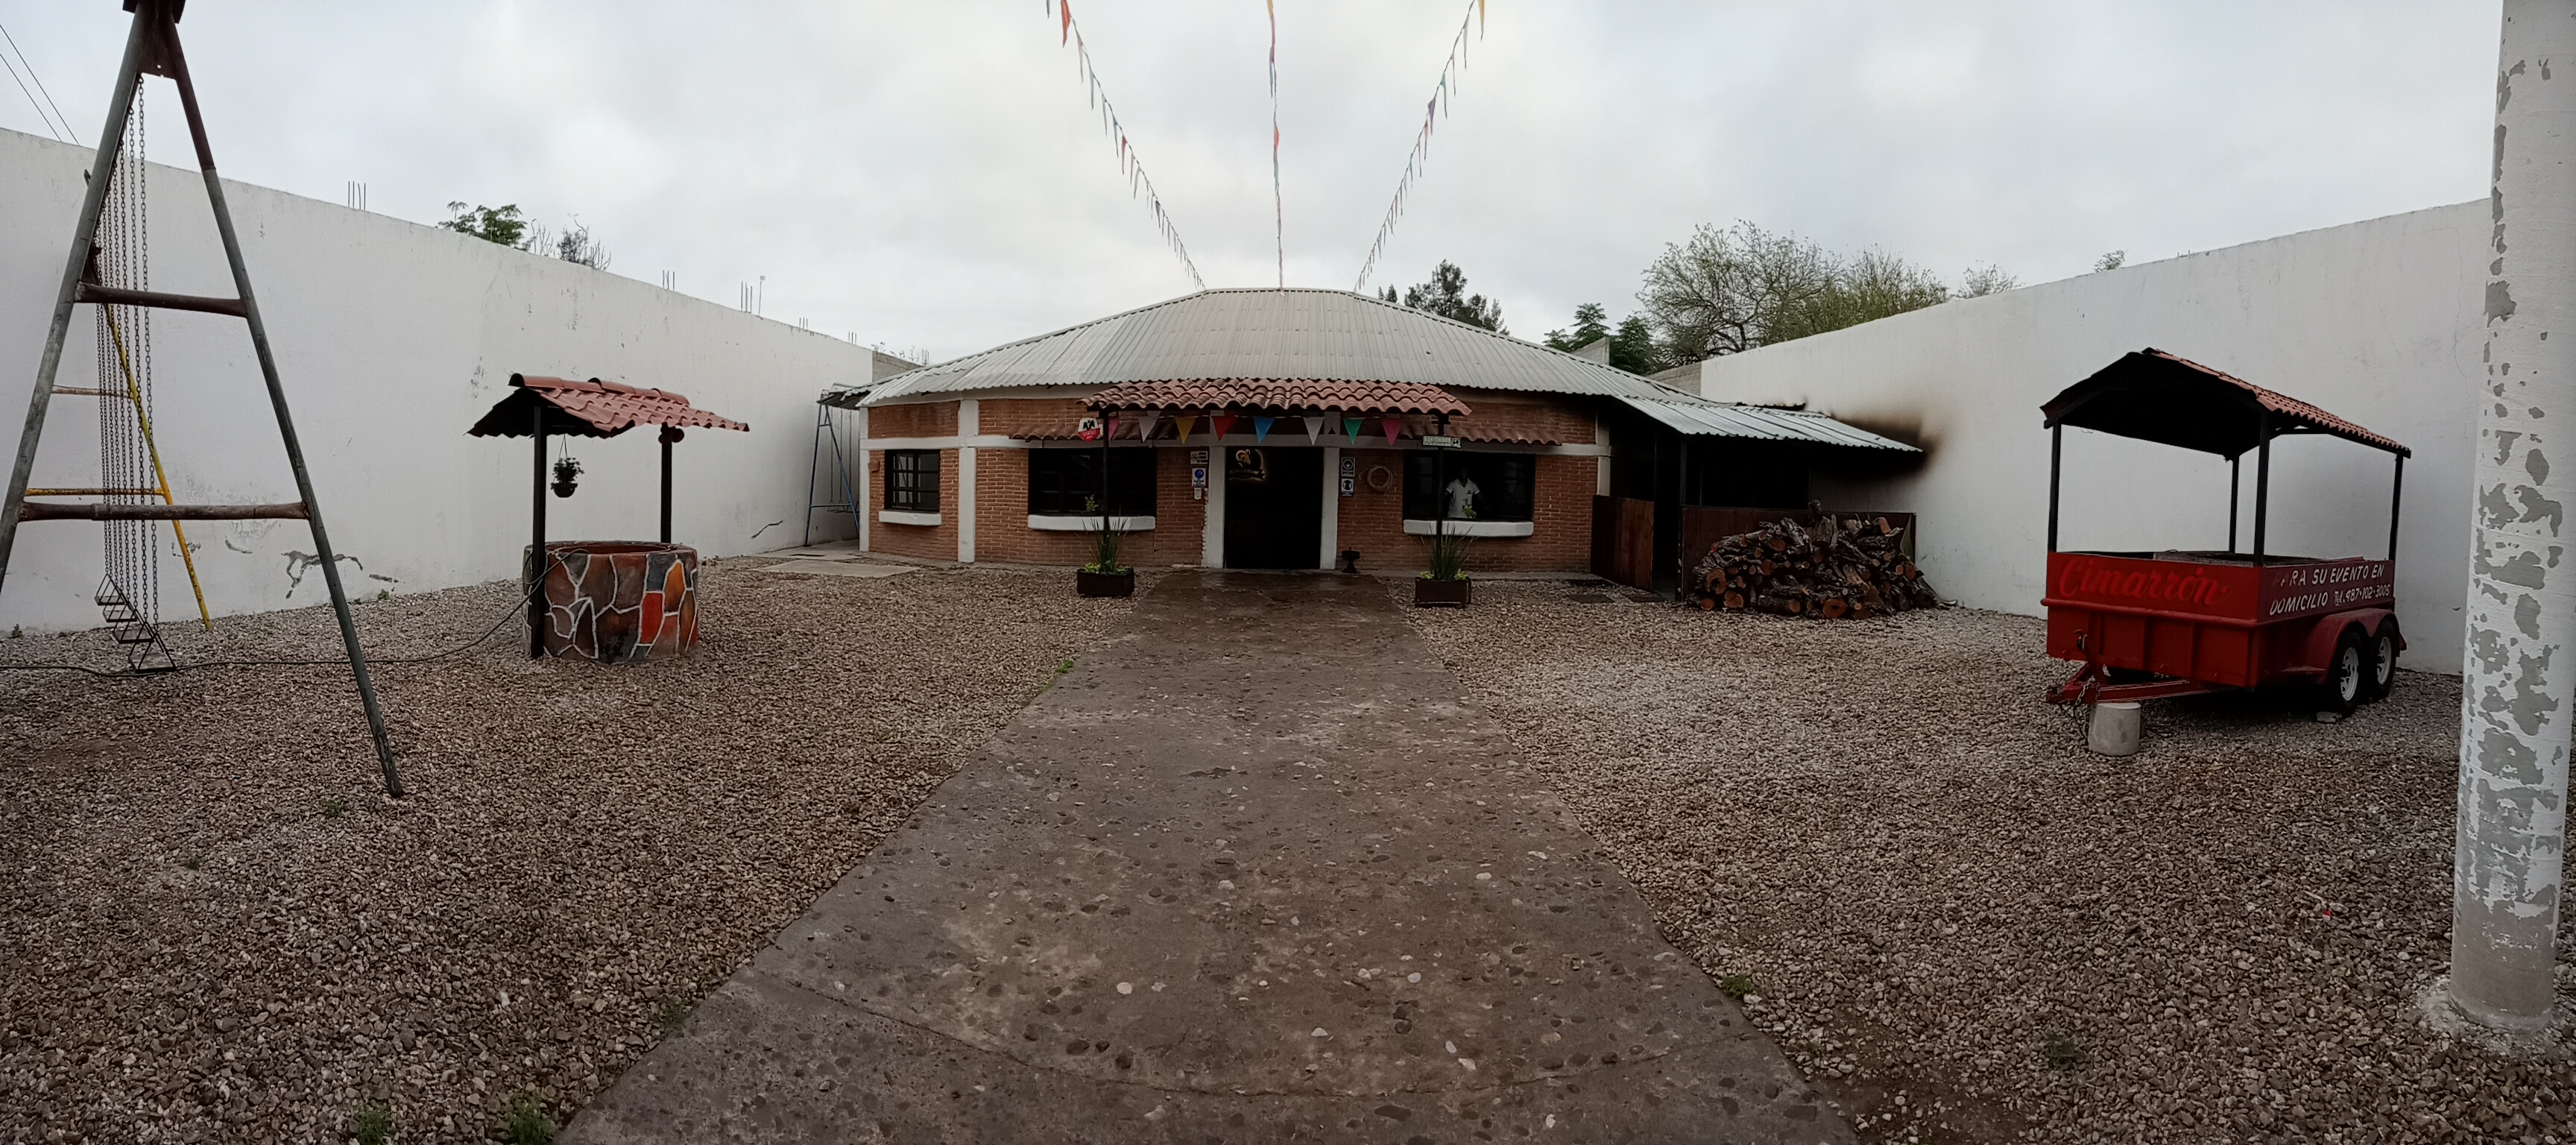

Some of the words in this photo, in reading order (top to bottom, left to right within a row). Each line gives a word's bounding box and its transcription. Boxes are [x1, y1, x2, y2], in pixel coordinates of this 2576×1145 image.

[2059, 559, 2232, 605] Cimarrón
[2311, 569, 2328, 585] SU
[2330, 565, 2369, 584] EVENTO
[2371, 564, 2384, 578] EN
[2269, 591, 2329, 616] DOMICILIO
